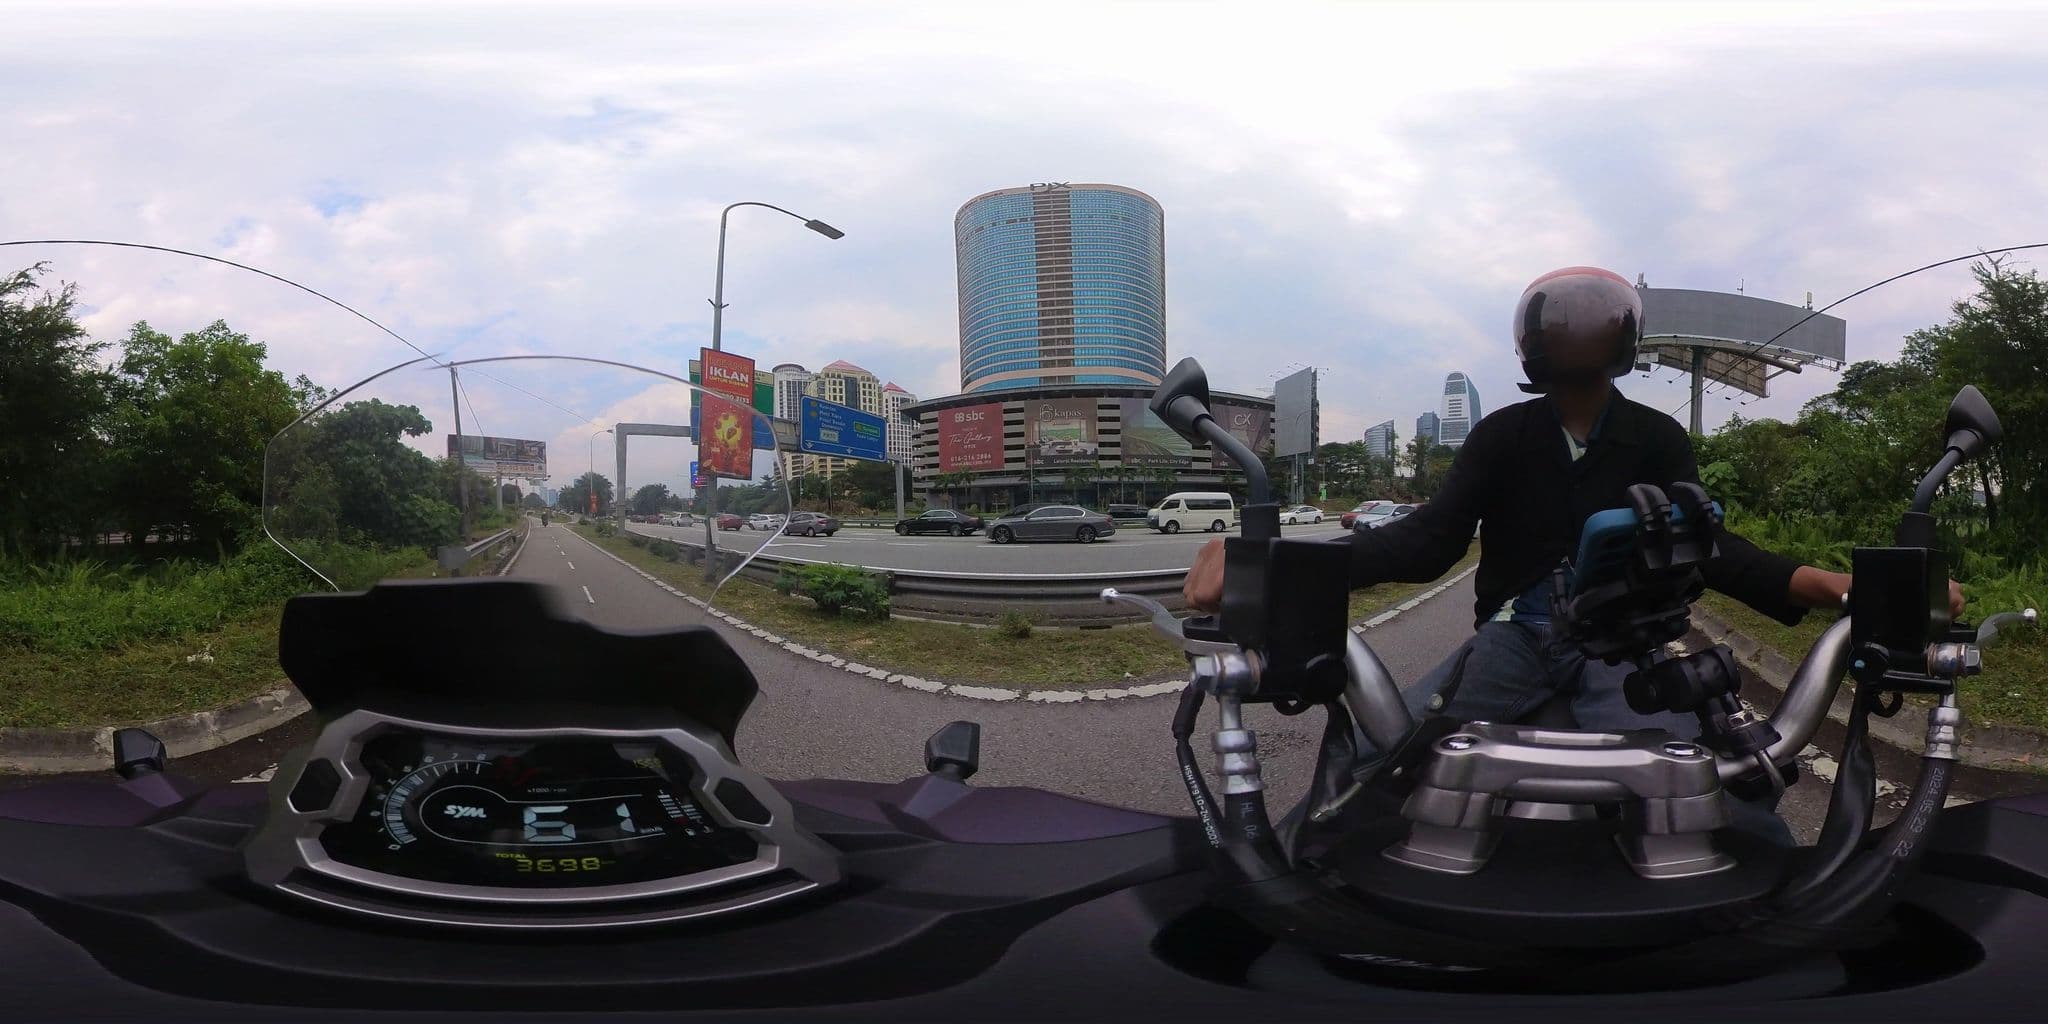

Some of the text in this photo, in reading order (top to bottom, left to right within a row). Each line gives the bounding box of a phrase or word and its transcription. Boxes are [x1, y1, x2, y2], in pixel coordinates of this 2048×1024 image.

[709, 366, 749, 384] IKLAN
[966, 410, 985, 421] sbc
[963, 432, 992, 444] Gallery
[1929, 767, 1945, 795] 2024
[444, 804, 488, 819] SYM
[523, 805, 636, 843] 61
[496, 852, 527, 860] TOTAL
[517, 857, 600, 873] 3698
